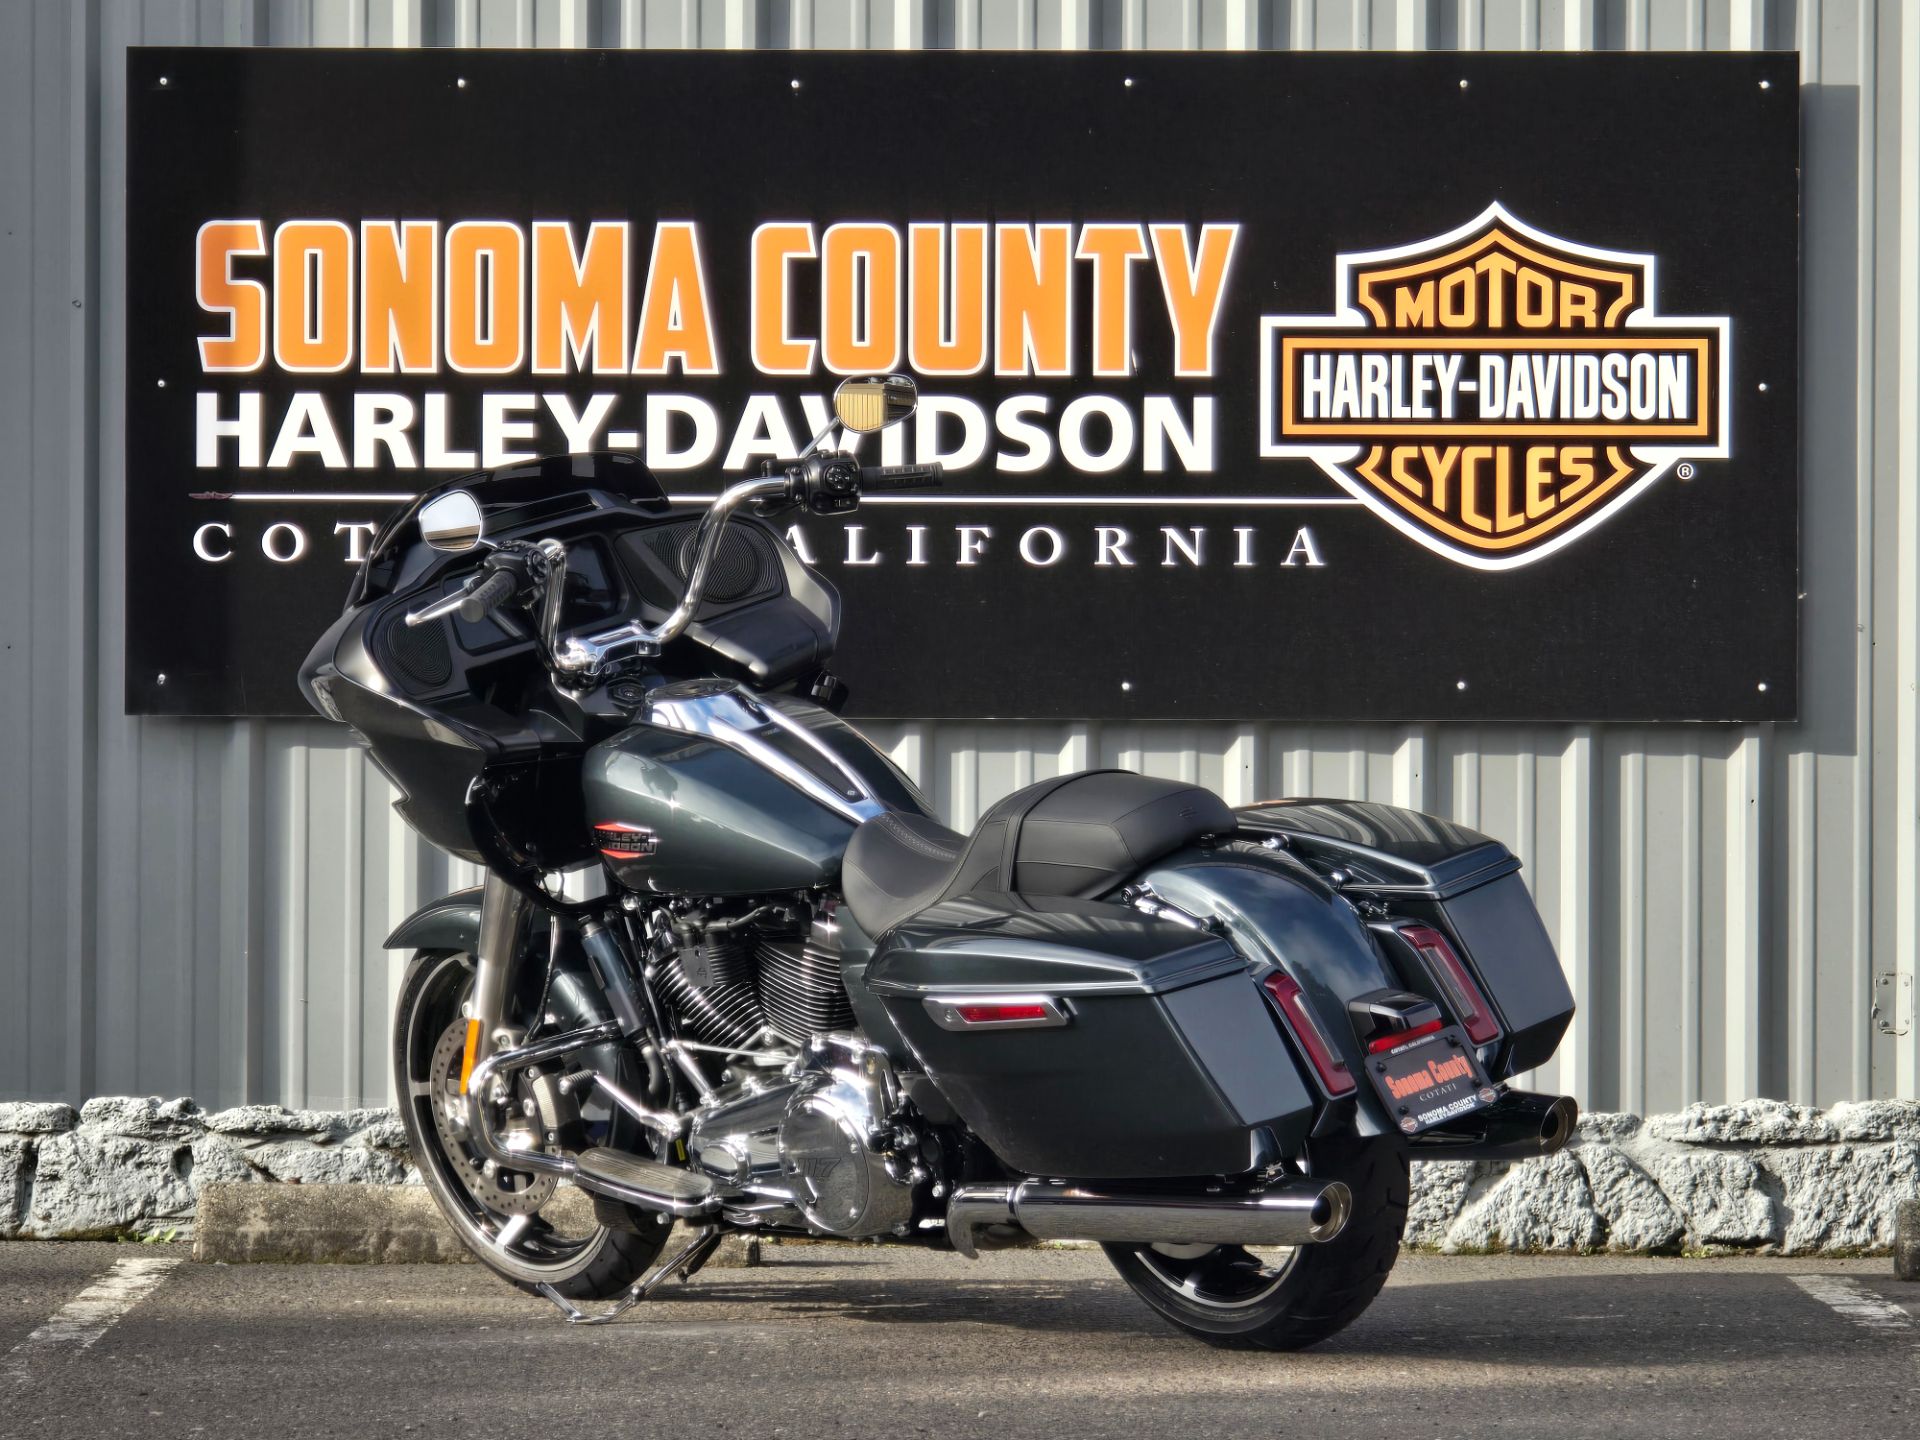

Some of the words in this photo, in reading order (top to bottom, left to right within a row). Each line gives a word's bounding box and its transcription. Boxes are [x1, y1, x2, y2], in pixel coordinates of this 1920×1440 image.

[195, 218, 720, 375] SONOMA
[750, 222, 1240, 378] COUNTY
[1395, 252, 1598, 329] MOTOR
[1302, 352, 1689, 421] HARLEY-DAVIDSON
[1390, 446, 1595, 533] CYCLES
[192, 521, 376, 564] COT
[785, 524, 1327, 567] ALIFORNIA
[1384, 1070, 1435, 1099] Sonoma
[1427, 1054, 1472, 1083] County
[1419, 1083, 1457, 1102] COTATI
[1417, 1105, 1449, 1122] SONOMA
[1448, 1094, 1477, 1110] COUNTY
